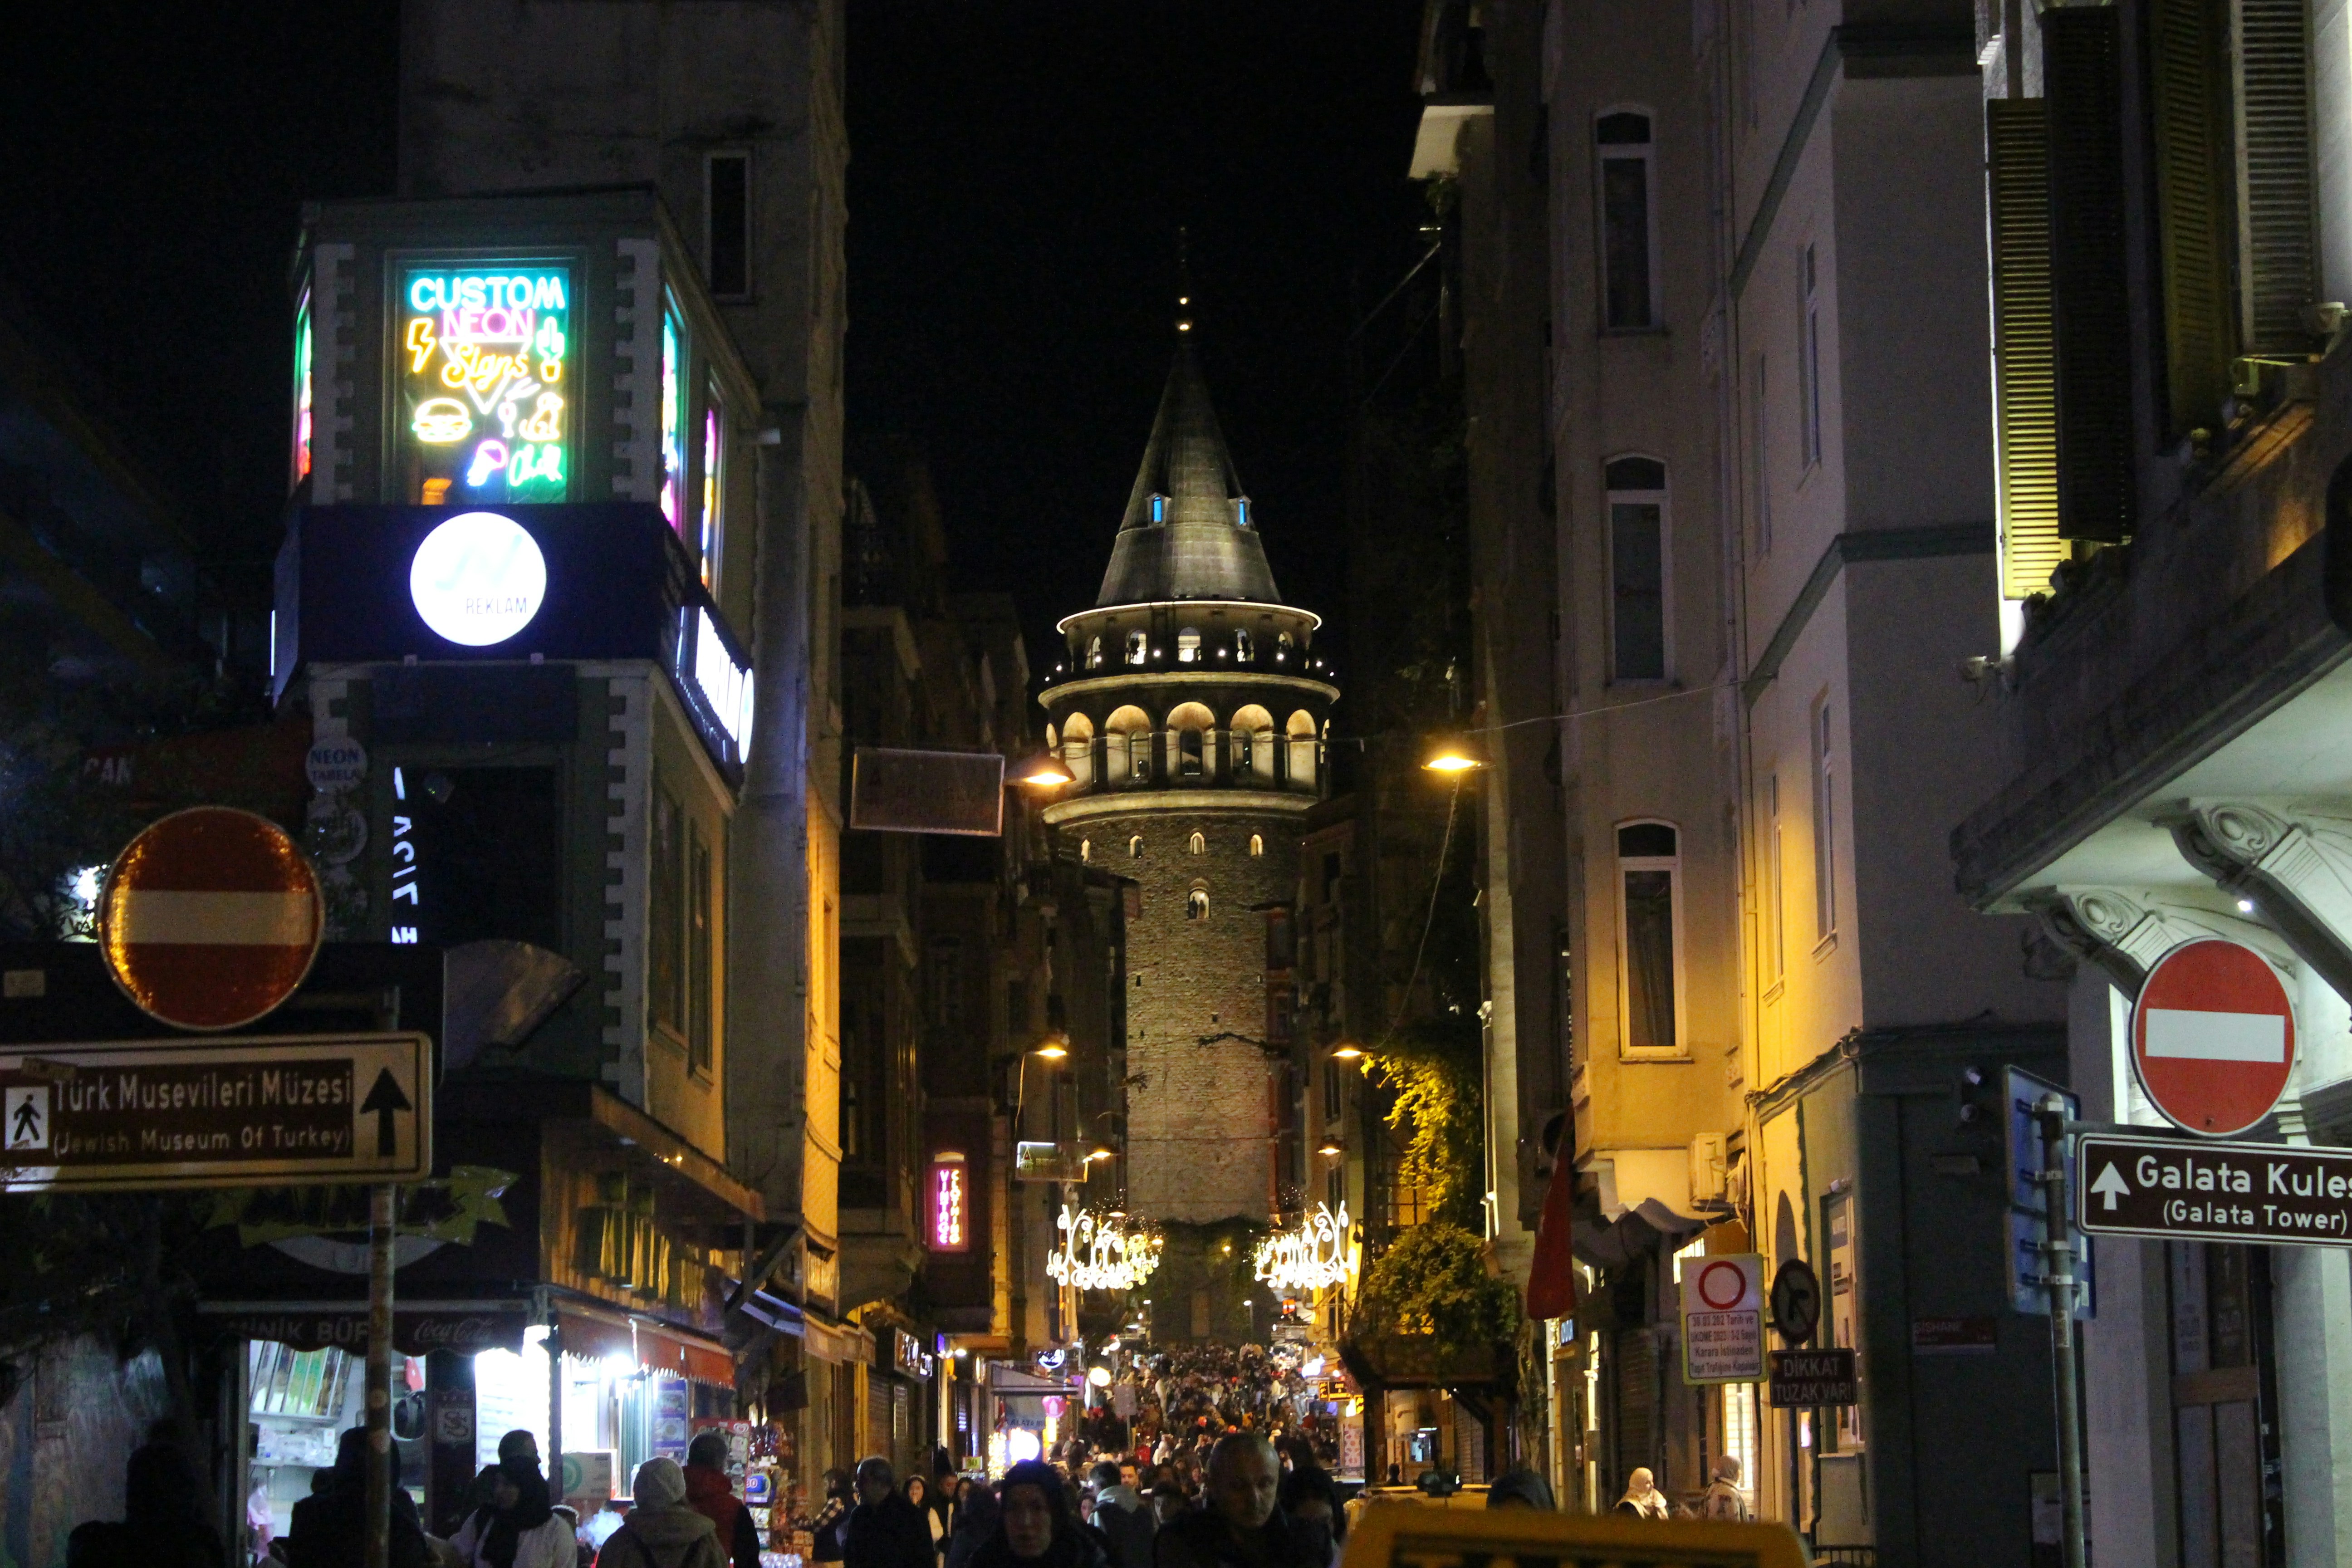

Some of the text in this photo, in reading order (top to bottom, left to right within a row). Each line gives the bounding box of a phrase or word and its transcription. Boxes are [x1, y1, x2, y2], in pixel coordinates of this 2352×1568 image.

[411, 276, 565, 311] CUSTOM
[443, 308, 533, 337] NEON
[441, 343, 529, 389] Signs
[466, 597, 527, 614] REKLAM
[311, 748, 359, 764] NEON
[54, 1070, 351, 1112] Türk Musevileri Müzesi
[142, 1129, 230, 1150] Museum
[272, 1125, 350, 1153] Turkey)
[2136, 1155, 2251, 1194] Galata
[938, 1170, 950, 1244] VINTAGE
[949, 1170, 961, 1244] CLOTHING
[2164, 1199, 2347, 1235] (Galata Tower)
[1784, 1356, 1839, 1377] DİKKAT
[1774, 1383, 1819, 1401] TUZAK
